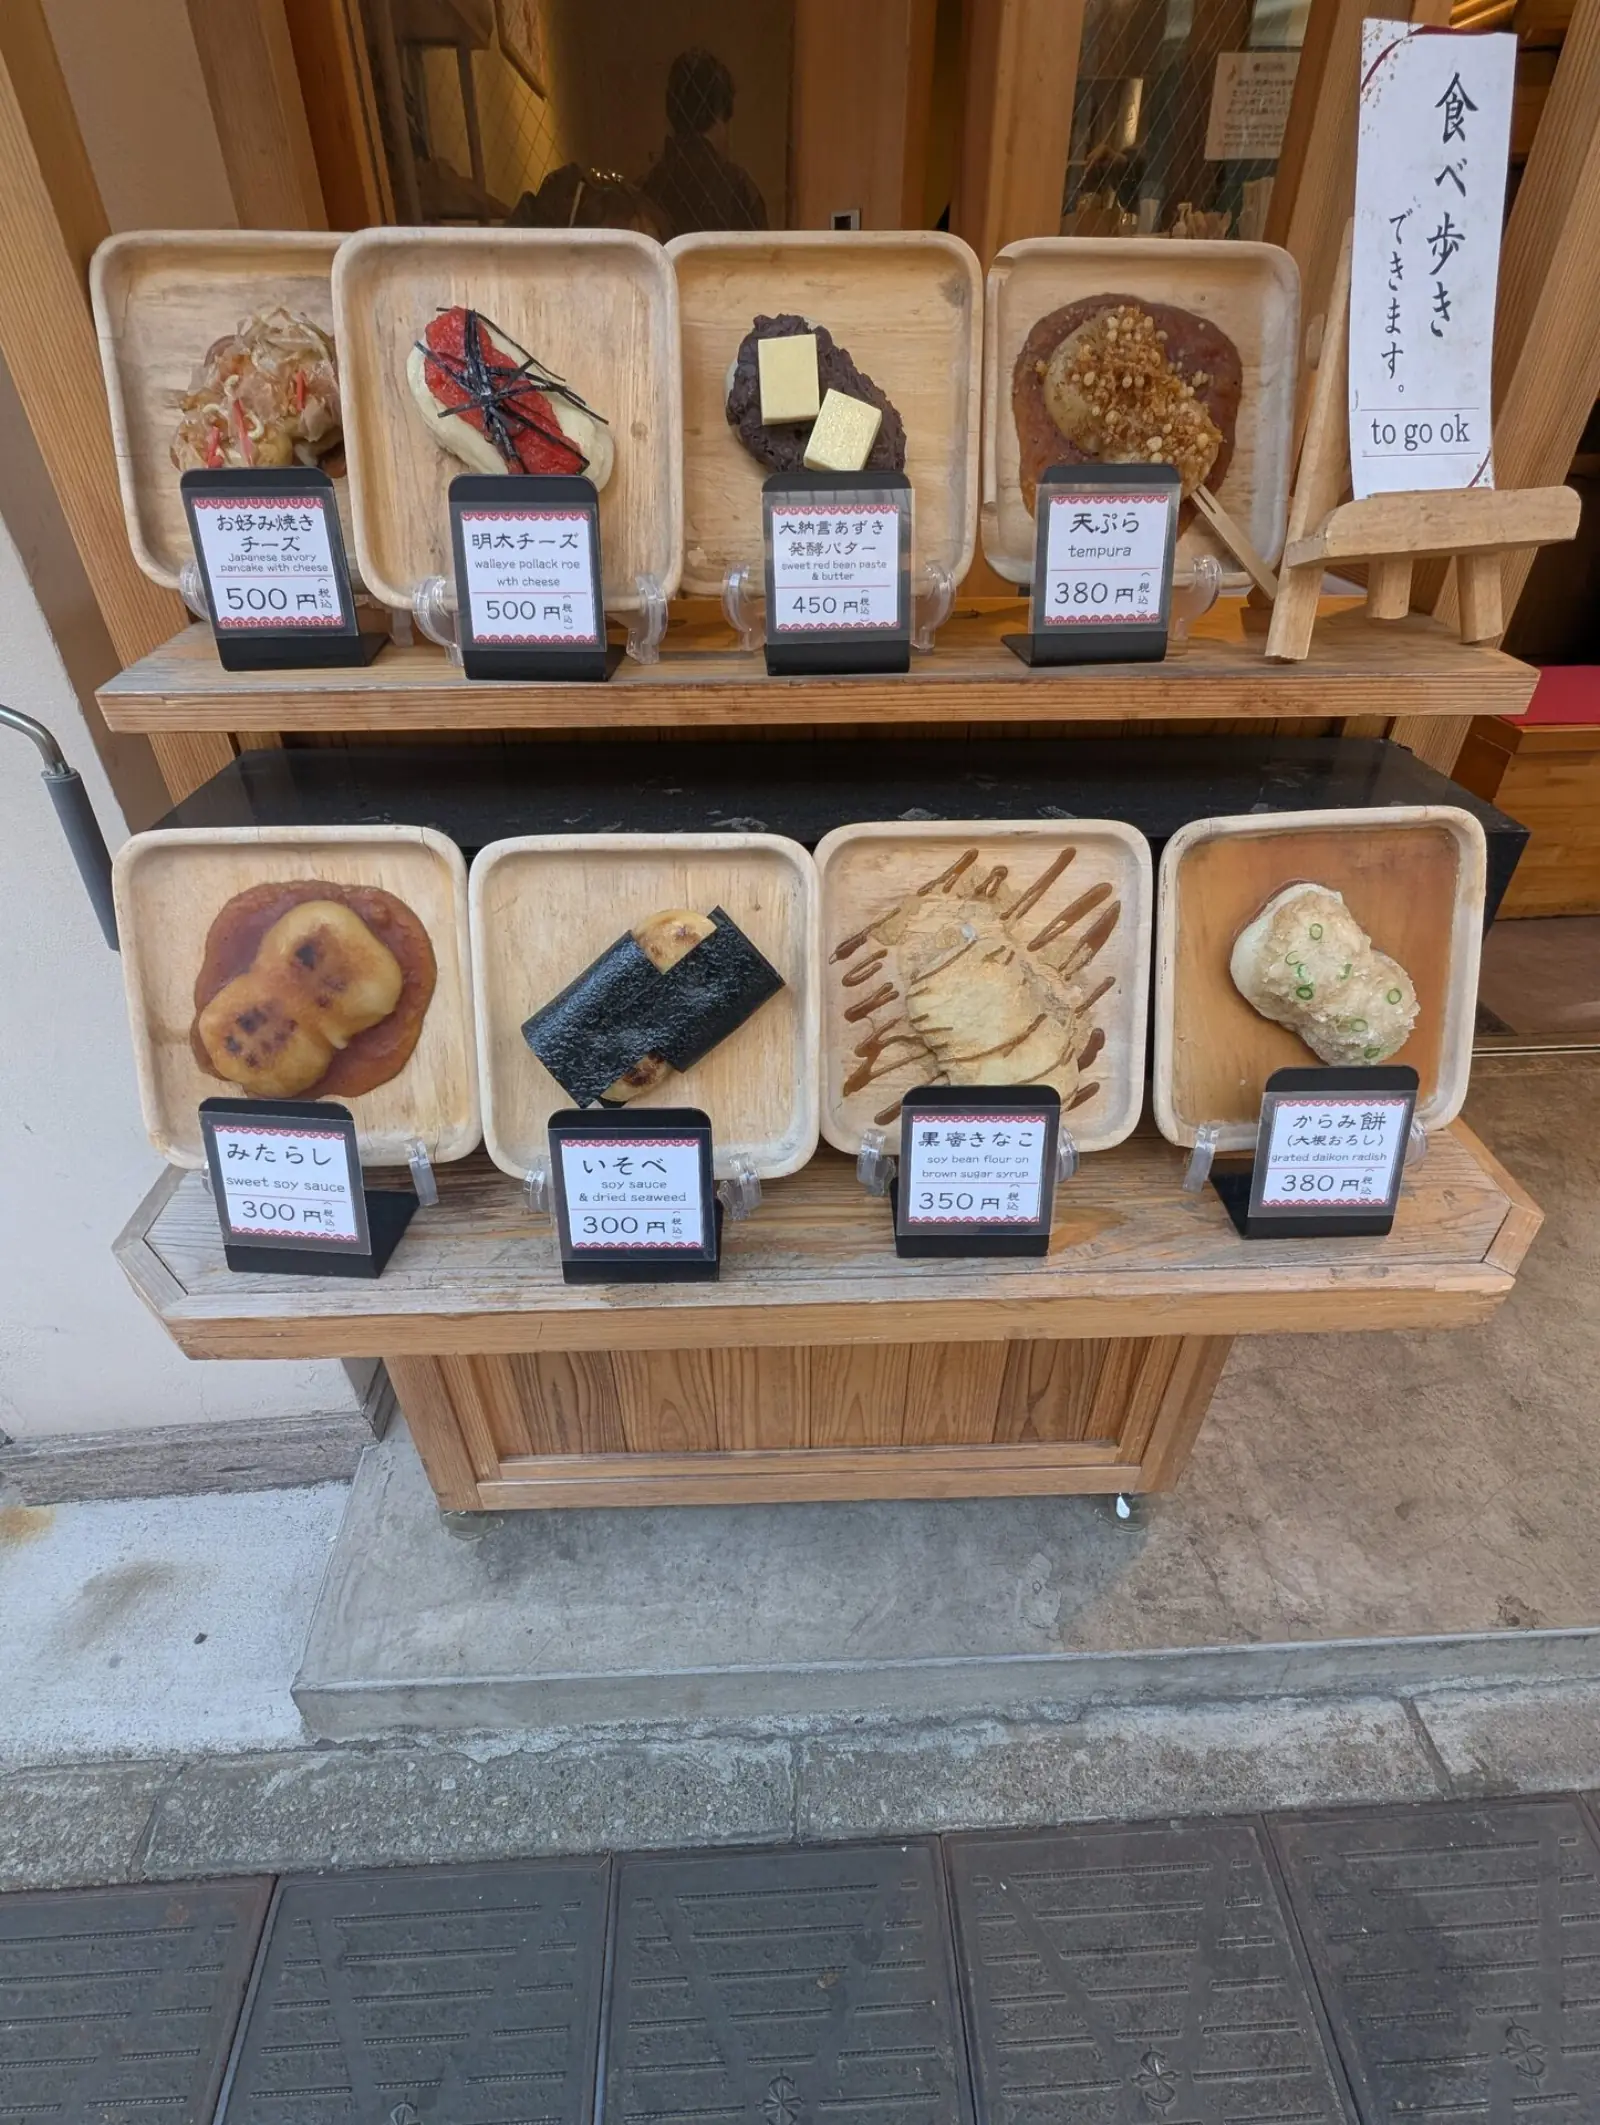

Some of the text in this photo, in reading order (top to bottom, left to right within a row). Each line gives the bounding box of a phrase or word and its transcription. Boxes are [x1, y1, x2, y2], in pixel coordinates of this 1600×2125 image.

[1427, 71, 1479, 338] 食べ歩き
[1381, 208, 1413, 393] できます。
[1371, 414, 1470, 451] to go ok
[217, 514, 314, 531] お好み焼き
[779, 520, 884, 535] 大納言あずき
[1070, 512, 1139, 534] 天ぷら
[241, 536, 300, 553] チーズ
[472, 533, 579, 550] 明太チーズ
[789, 542, 876, 557] 発酵バター
[1068, 545, 1132, 558] tempura
[228, 554, 316, 562] Japanese savory
[475, 559, 580, 570] walleye pollack roe
[782, 560, 887, 570] sweet red bean paste
[220, 563, 328, 572] pancake with cheese
[497, 577, 560, 587] wth cheese
[812, 572, 854, 580] & butter
[1293, 1112, 1386, 1130] からみ餅
[1287, 1135, 1384, 1146] (大根おろし)
[227, 1143, 331, 1165] みたらし
[927, 1156, 948, 1164] soy
[984, 1155, 1011, 1163] flour
[1272, 1153, 1387, 1162] grated daikon radish
[583, 1157, 667, 1175] いそべ
[922, 1170, 1028, 1179] brown sugar syrup
[226, 1177, 345, 1192] sweet soy sauce
[602, 1181, 624, 1190] soy
[579, 1193, 686, 1202] & dried seaweed
